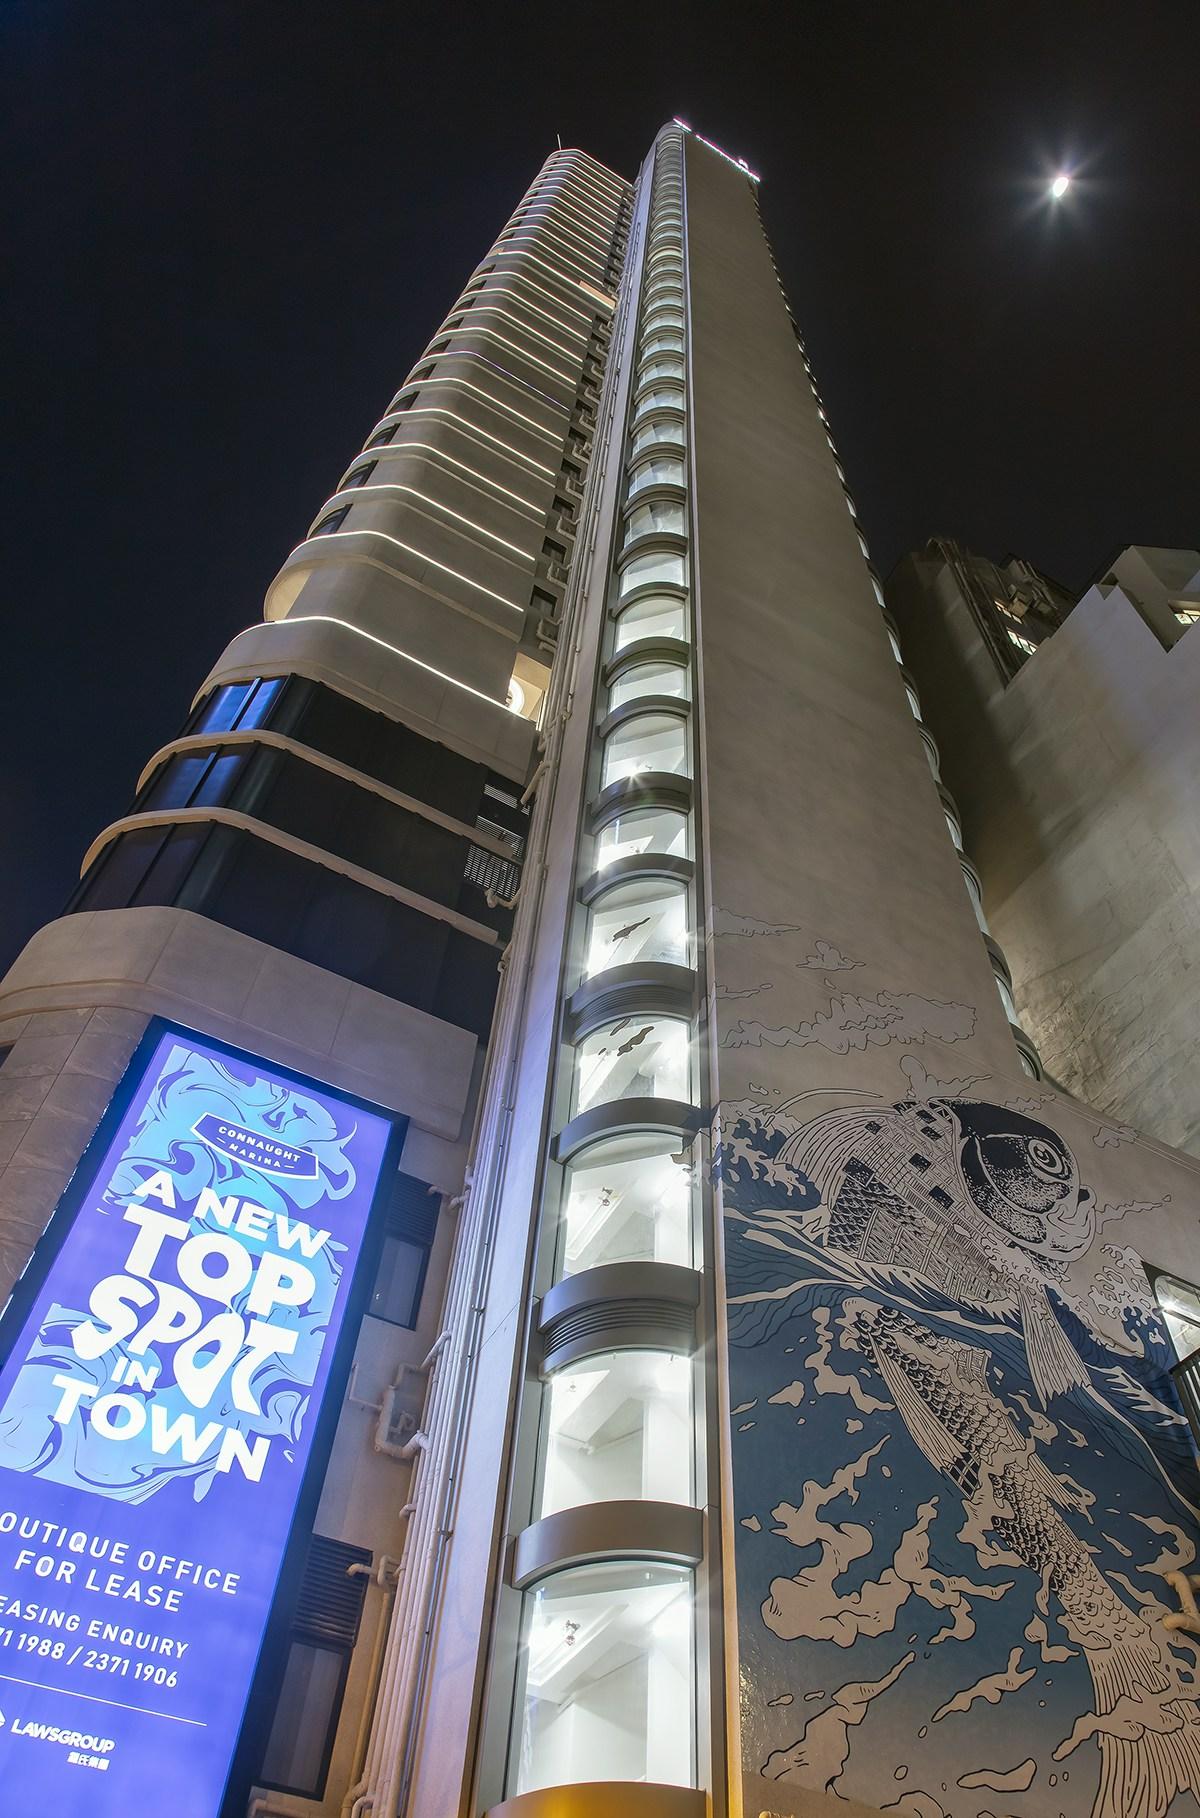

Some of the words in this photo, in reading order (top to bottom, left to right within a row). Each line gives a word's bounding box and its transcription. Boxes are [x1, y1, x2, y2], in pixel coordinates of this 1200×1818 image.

[218, 1126, 301, 1162] CONNAUGHT
[228, 1143, 282, 1168] MARINA
[132, 1169, 177, 1209] A
[192, 1186, 332, 1259] NEW
[122, 1203, 316, 1317] TOP
[71, 1274, 299, 1416] SPOT
[110, 1355, 160, 1393] IN
[51, 1373, 271, 1483] TOWN
[14, 1549, 77, 1584] FOR
[85, 1568, 184, 1612] LEASE
[137, 1550, 241, 1595] OFFICE
[17, 1633, 66, 1660] 1988
[83, 1650, 130, 1676] 2371
[134, 1662, 178, 1688] 1906
[86, 1619, 189, 1659] ENQUIRY
[10, 1718, 116, 1754] LAWSGROUP
